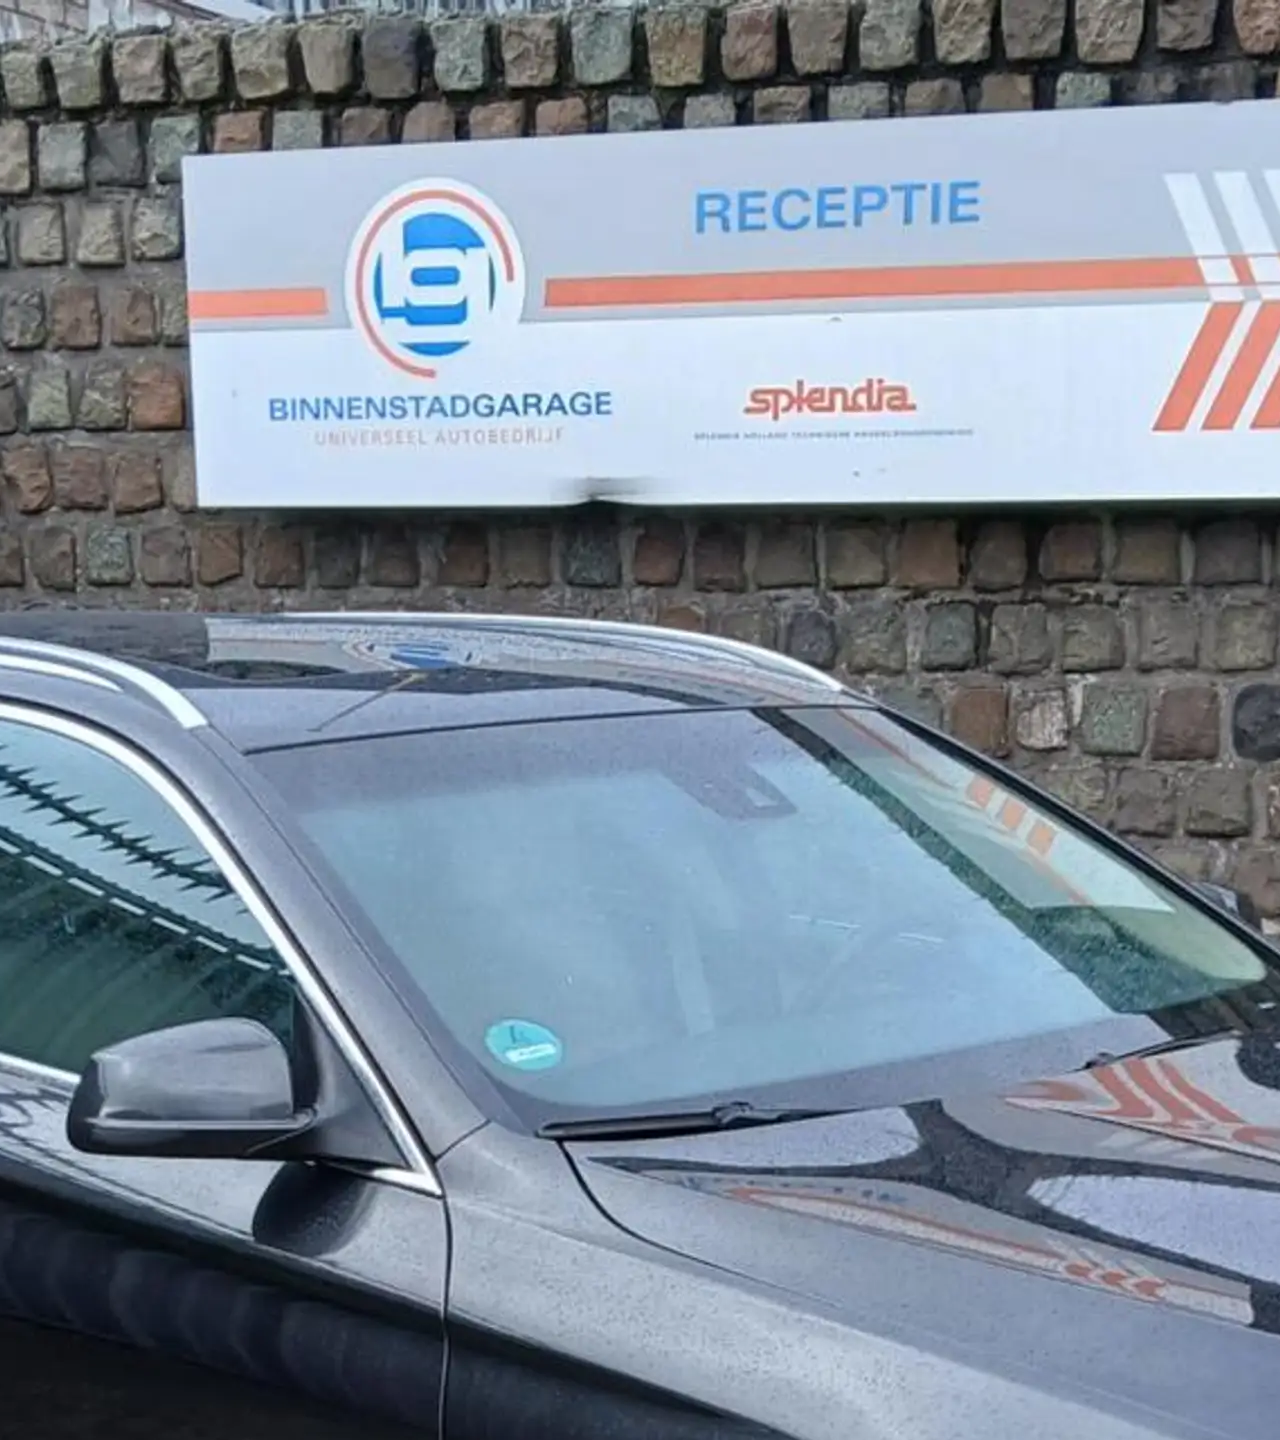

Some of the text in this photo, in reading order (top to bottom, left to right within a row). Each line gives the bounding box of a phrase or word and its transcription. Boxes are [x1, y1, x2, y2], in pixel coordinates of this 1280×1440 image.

[695, 180, 981, 234] RECEPTIE
[268, 390, 614, 422] BINNENSTADGARAGE
[742, 377, 917, 422] splendia
[314, 425, 566, 447] UNIVERSEEL AUTOBEDRIJF
